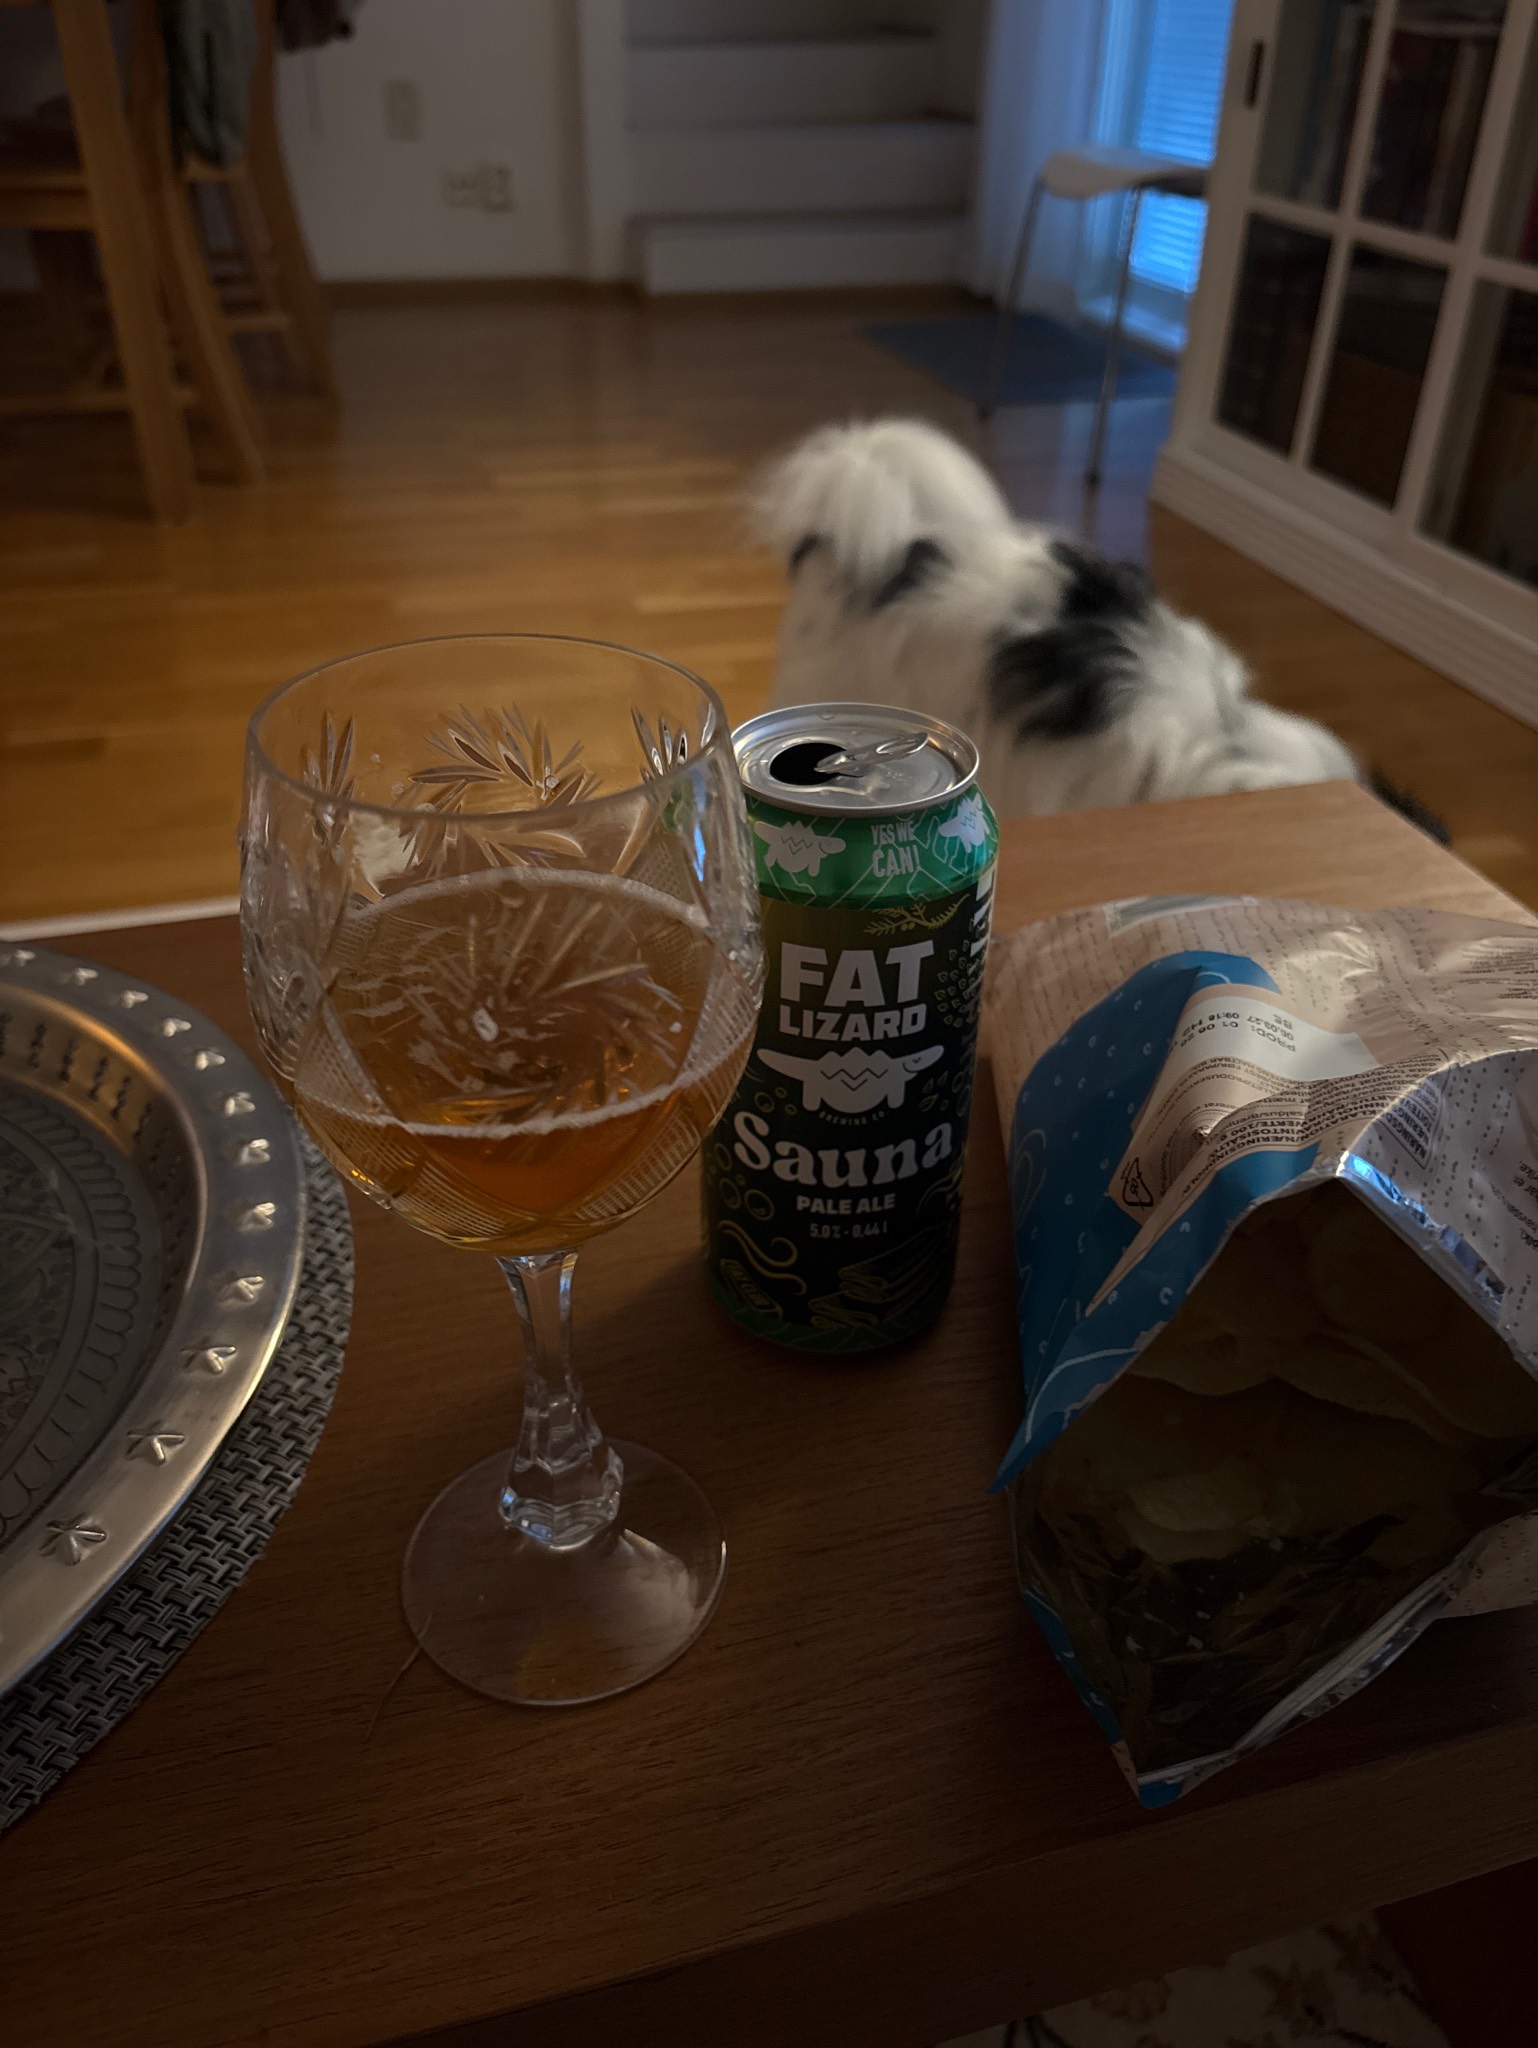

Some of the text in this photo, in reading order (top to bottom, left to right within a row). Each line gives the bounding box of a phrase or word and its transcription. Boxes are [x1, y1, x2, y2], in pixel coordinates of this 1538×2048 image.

[870, 822, 917, 845] YES WE
[872, 845, 920, 878] CAN!
[780, 940, 935, 1007] FAT
[779, 1003, 927, 1042] LIZARD
[1250, 1025, 1296, 1053] PROD:
[734, 1111, 953, 1188] Sauna
[796, 1193, 896, 1215] PALE ALE
[809, 1223, 841, 1239] 5.0%
